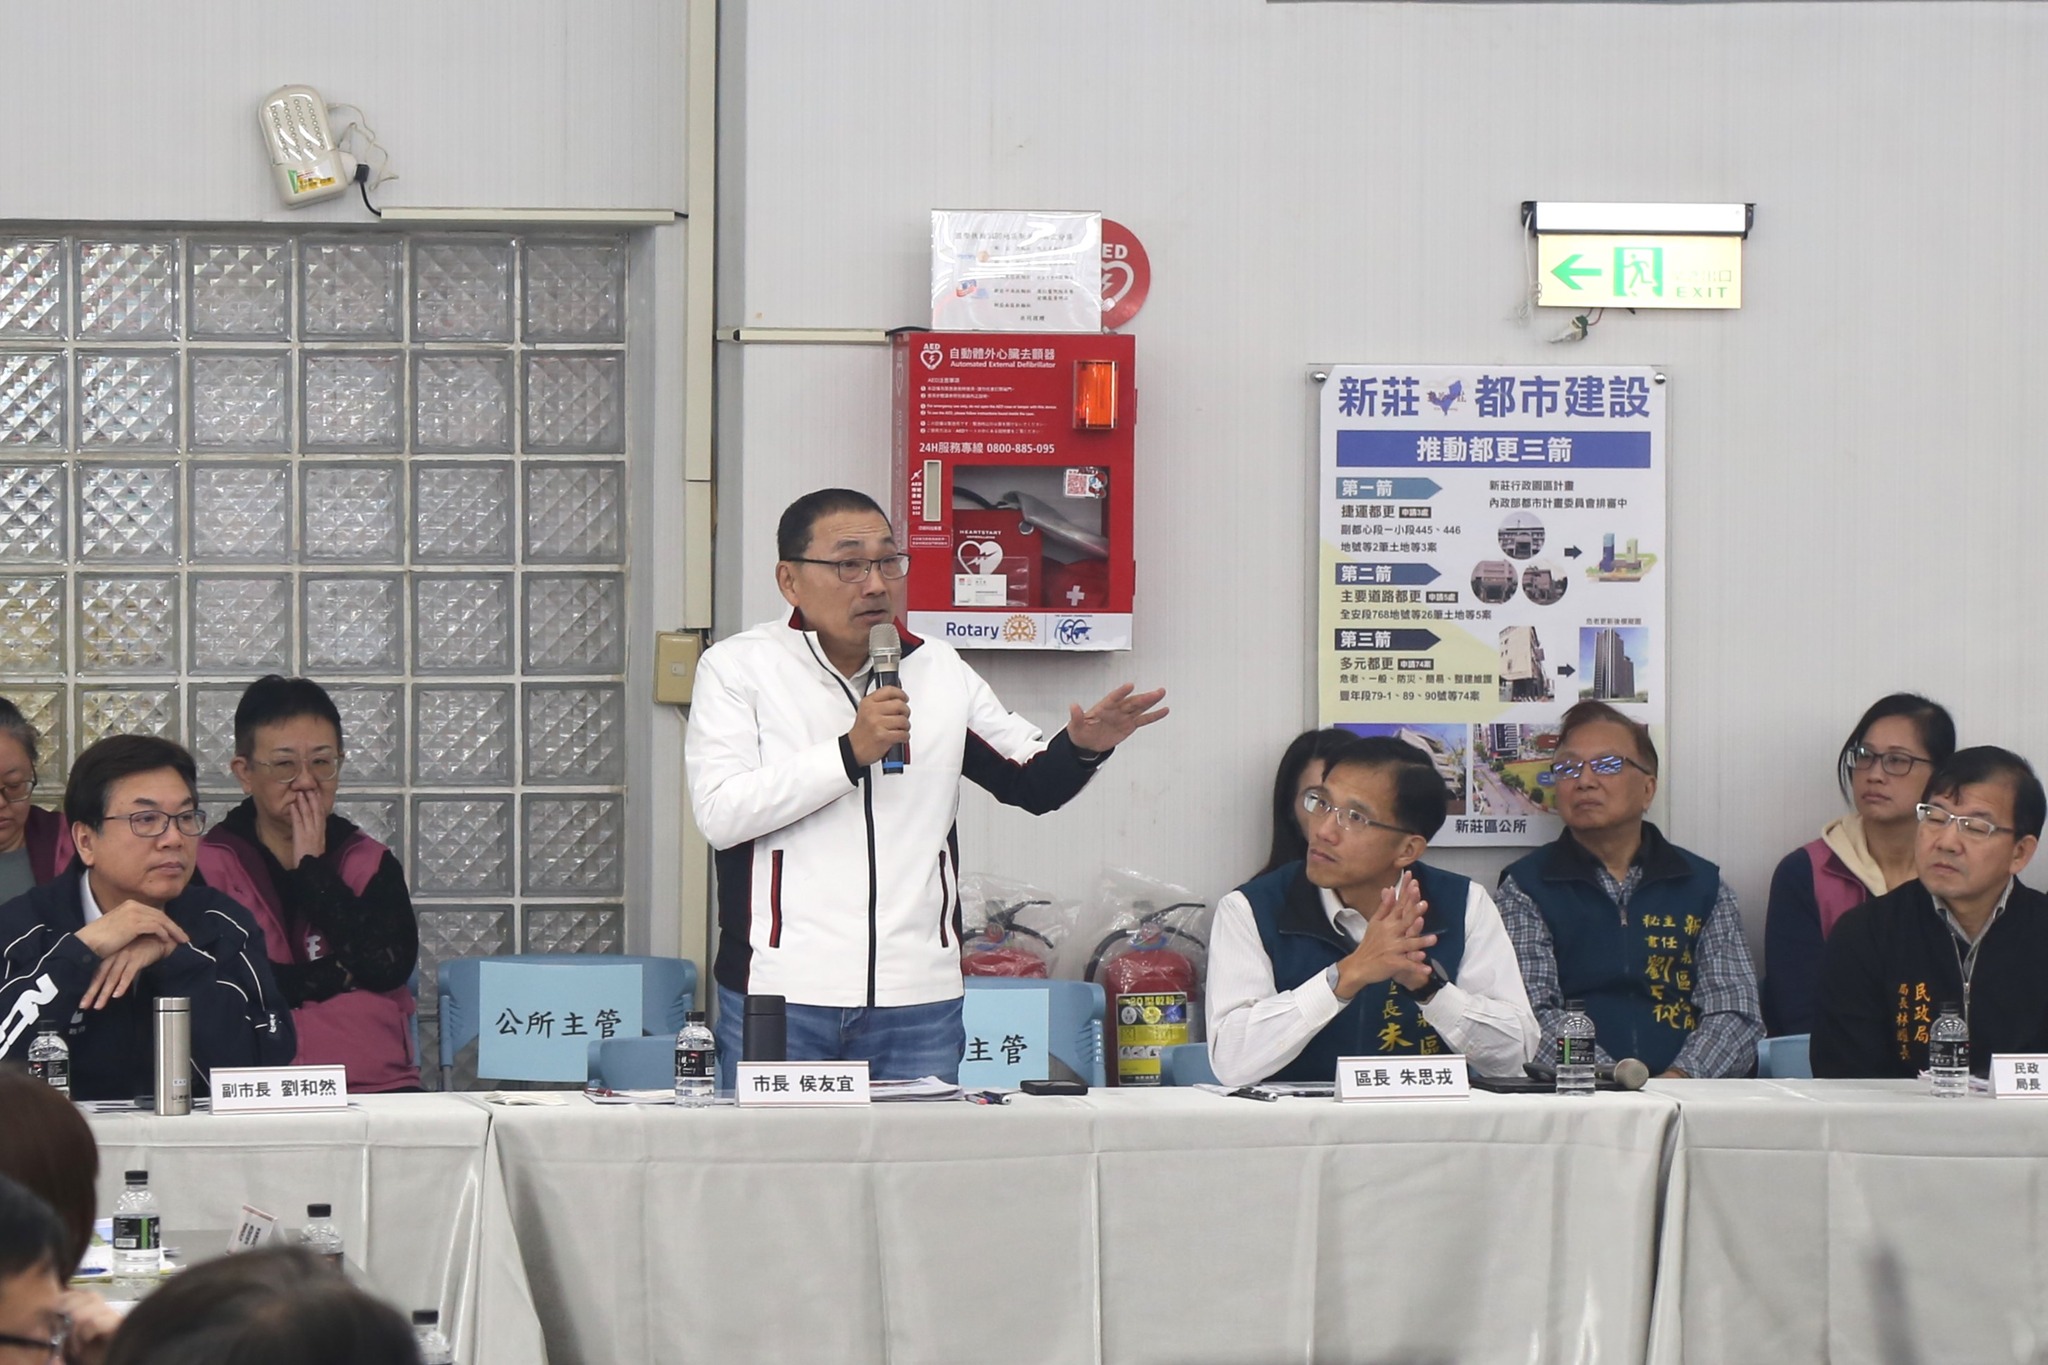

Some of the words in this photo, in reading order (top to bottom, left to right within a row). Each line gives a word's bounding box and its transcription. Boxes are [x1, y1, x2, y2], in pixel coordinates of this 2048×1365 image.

[1676, 286, 1728, 299] EXIT
[923, 343, 941, 351] AED
[949, 347, 1056, 360] 自動體外心臟去顫器
[950, 360, 988, 369] Automated
[988, 361, 1016, 369] External
[1017, 361, 1057, 369] Defibrillator
[1338, 375, 1420, 418] 新莊
[1474, 374, 1651, 418] 都市建設
[919, 441, 984, 455] 24H服務專線
[986, 442, 1055, 454] 0800-885-095
[1416, 436, 1573, 463] 推動都更三箭
[1341, 479, 1393, 497] 第一箭
[1488, 480, 1575, 492] 新莊行政園區計畫
[1341, 504, 1396, 519] 捷運都更
[1340, 542, 1438, 553] 地號等2筆土地等3案
[1340, 565, 1393, 582] 第二箭
[1340, 589, 1422, 604] 主要道路都更
[1340, 609, 1493, 621] 全安段768地號等26筆土地等5案
[945, 621, 1000, 640] Rotary
[1340, 630, 1392, 648] 第三箭
[1339, 656, 1394, 671] 多元都更
[1339, 690, 1480, 702] 豐年段79-1、89、90號等74案
[1454, 818, 1528, 834] 新莊區公所
[1913, 982, 1932, 1044] 民政局
[495, 1007, 623, 1040] 公所主管
[965, 1033, 1029, 1066] 主管
[2014, 1062, 2040, 1075] 民政
[752, 1074, 791, 1093] 市長
[799, 1074, 855, 1093] 侯友宜
[1354, 1068, 1391, 1087] 區長
[1400, 1067, 1454, 1086] 朱思戎
[2016, 1078, 2042, 1091] 局長
[221, 1081, 272, 1099] 副市長
[280, 1078, 338, 1097] 劉和然
